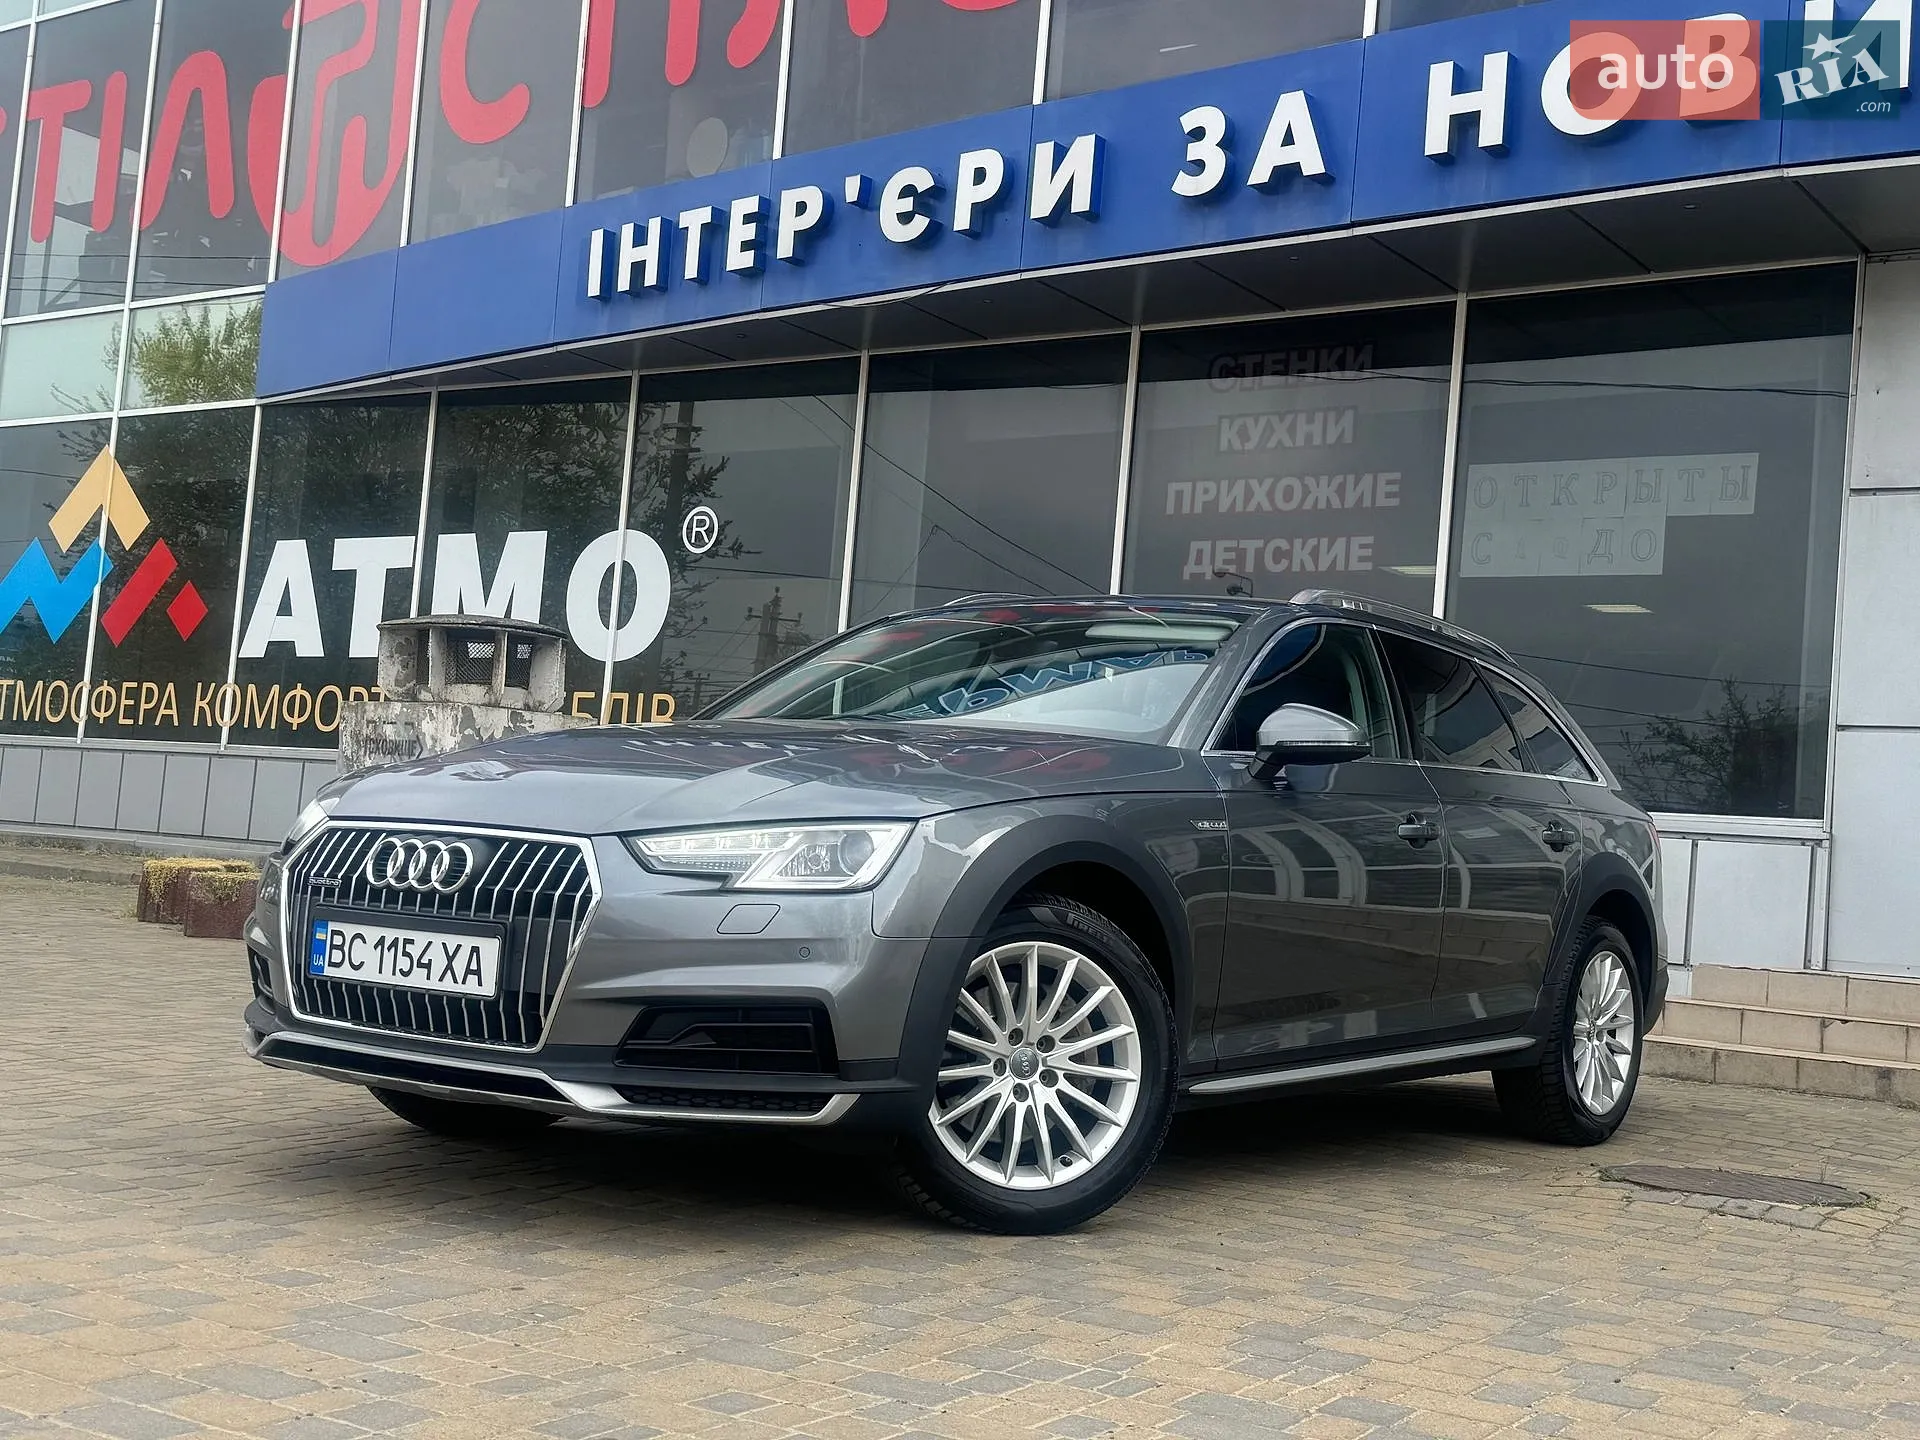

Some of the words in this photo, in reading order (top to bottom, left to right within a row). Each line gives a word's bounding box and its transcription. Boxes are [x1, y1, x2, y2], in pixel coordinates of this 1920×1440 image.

[587, 134, 1098, 298] ІНТЕР'ЄРИ
[1172, 89, 1328, 198] ЗА
[1209, 344, 1374, 393] СТЕНКИ
[1219, 408, 1356, 452] КУХНИ
[1165, 471, 1402, 516] ПРИХОЖИЕ
[1472, 464, 1752, 509] ОТКРЫТЫ
[1182, 535, 1375, 581] ДЕТСКИЕ
[238, 529, 672, 663] АТМО
[313, 957, 324, 966] UA
[327, 929, 367, 971] BC
[373, 935, 434, 981] 1154
[438, 942, 483, 987] XA
